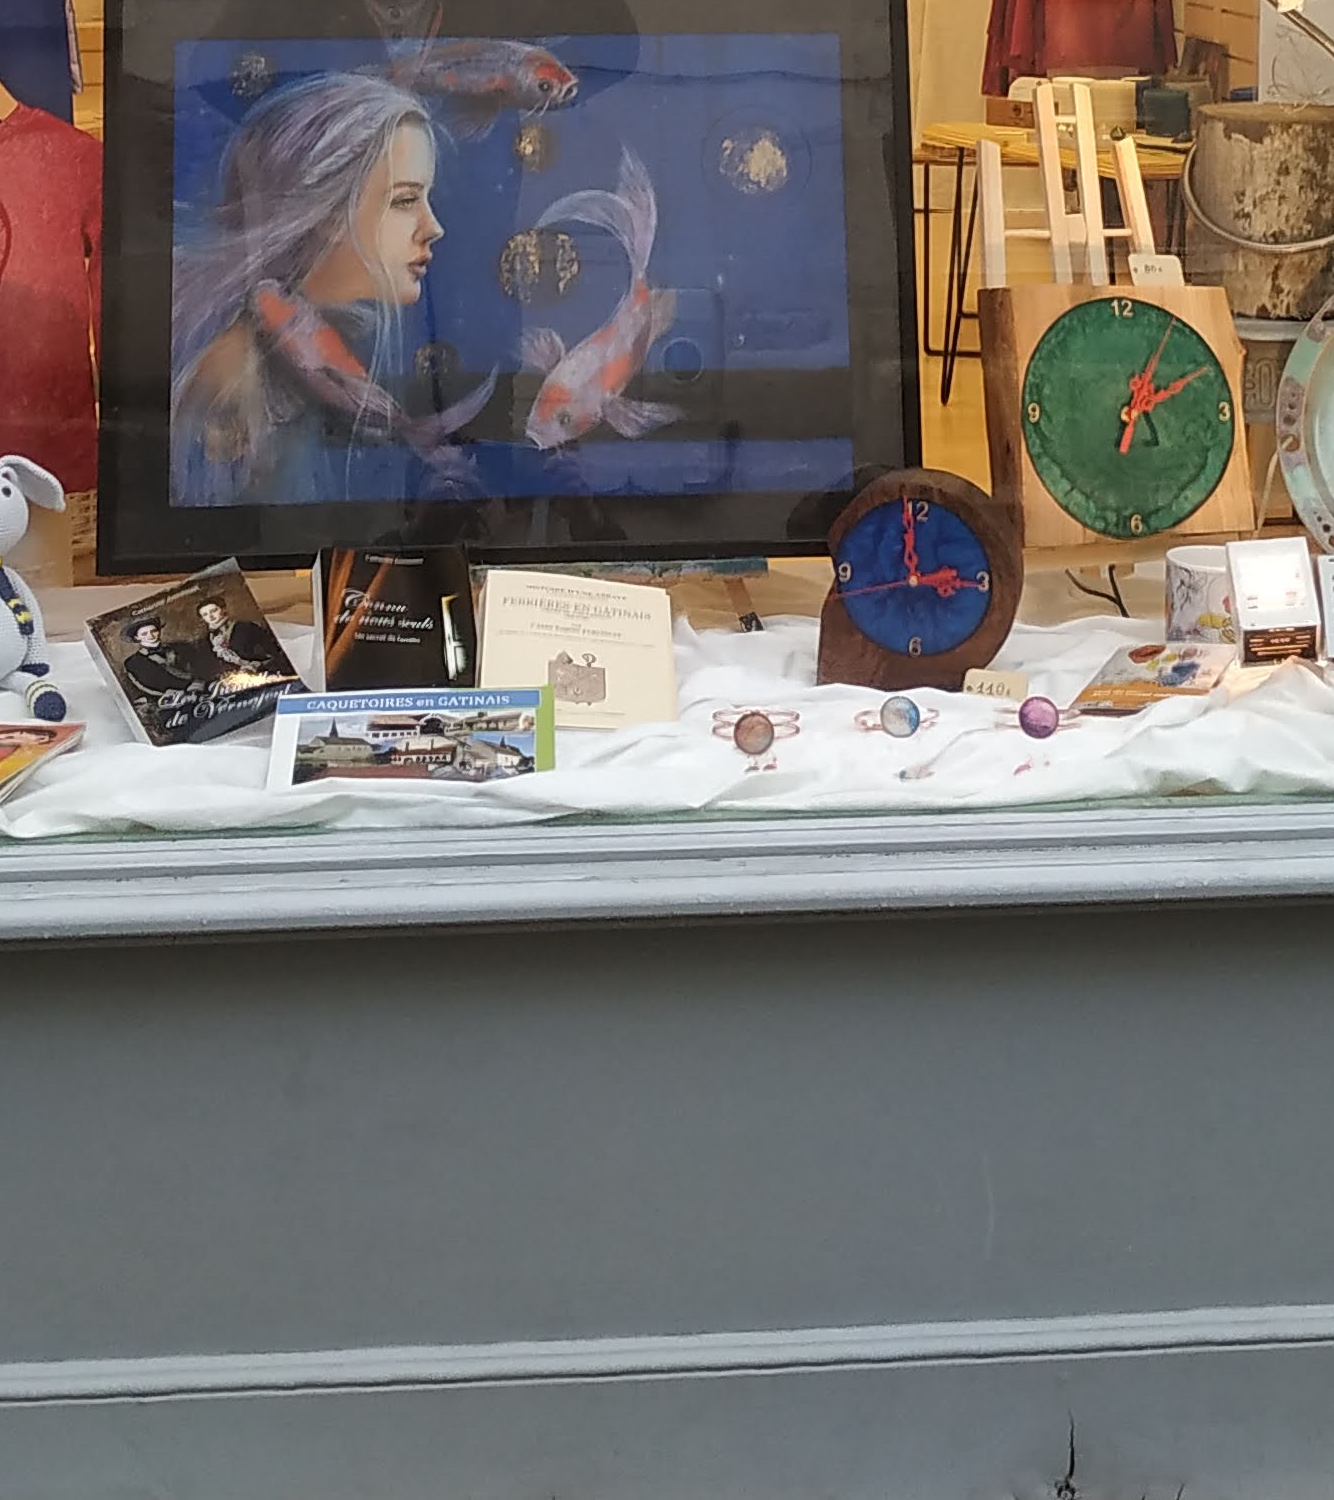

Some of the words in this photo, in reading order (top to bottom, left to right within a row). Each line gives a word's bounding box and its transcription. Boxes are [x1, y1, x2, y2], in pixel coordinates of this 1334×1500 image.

[1111, 300, 1134, 317] 12
[1028, 402, 1040, 423] 9
[1218, 401, 1231, 421] 3
[1130, 514, 1143, 534] 6
[838, 561, 852, 583] 9
[976, 571, 990, 593] 3
[908, 636, 922, 657] 6
[307, 696, 414, 711] CAQUETOIRES
[417, 699, 434, 708] en
[438, 695, 511, 707] GATINAIS
